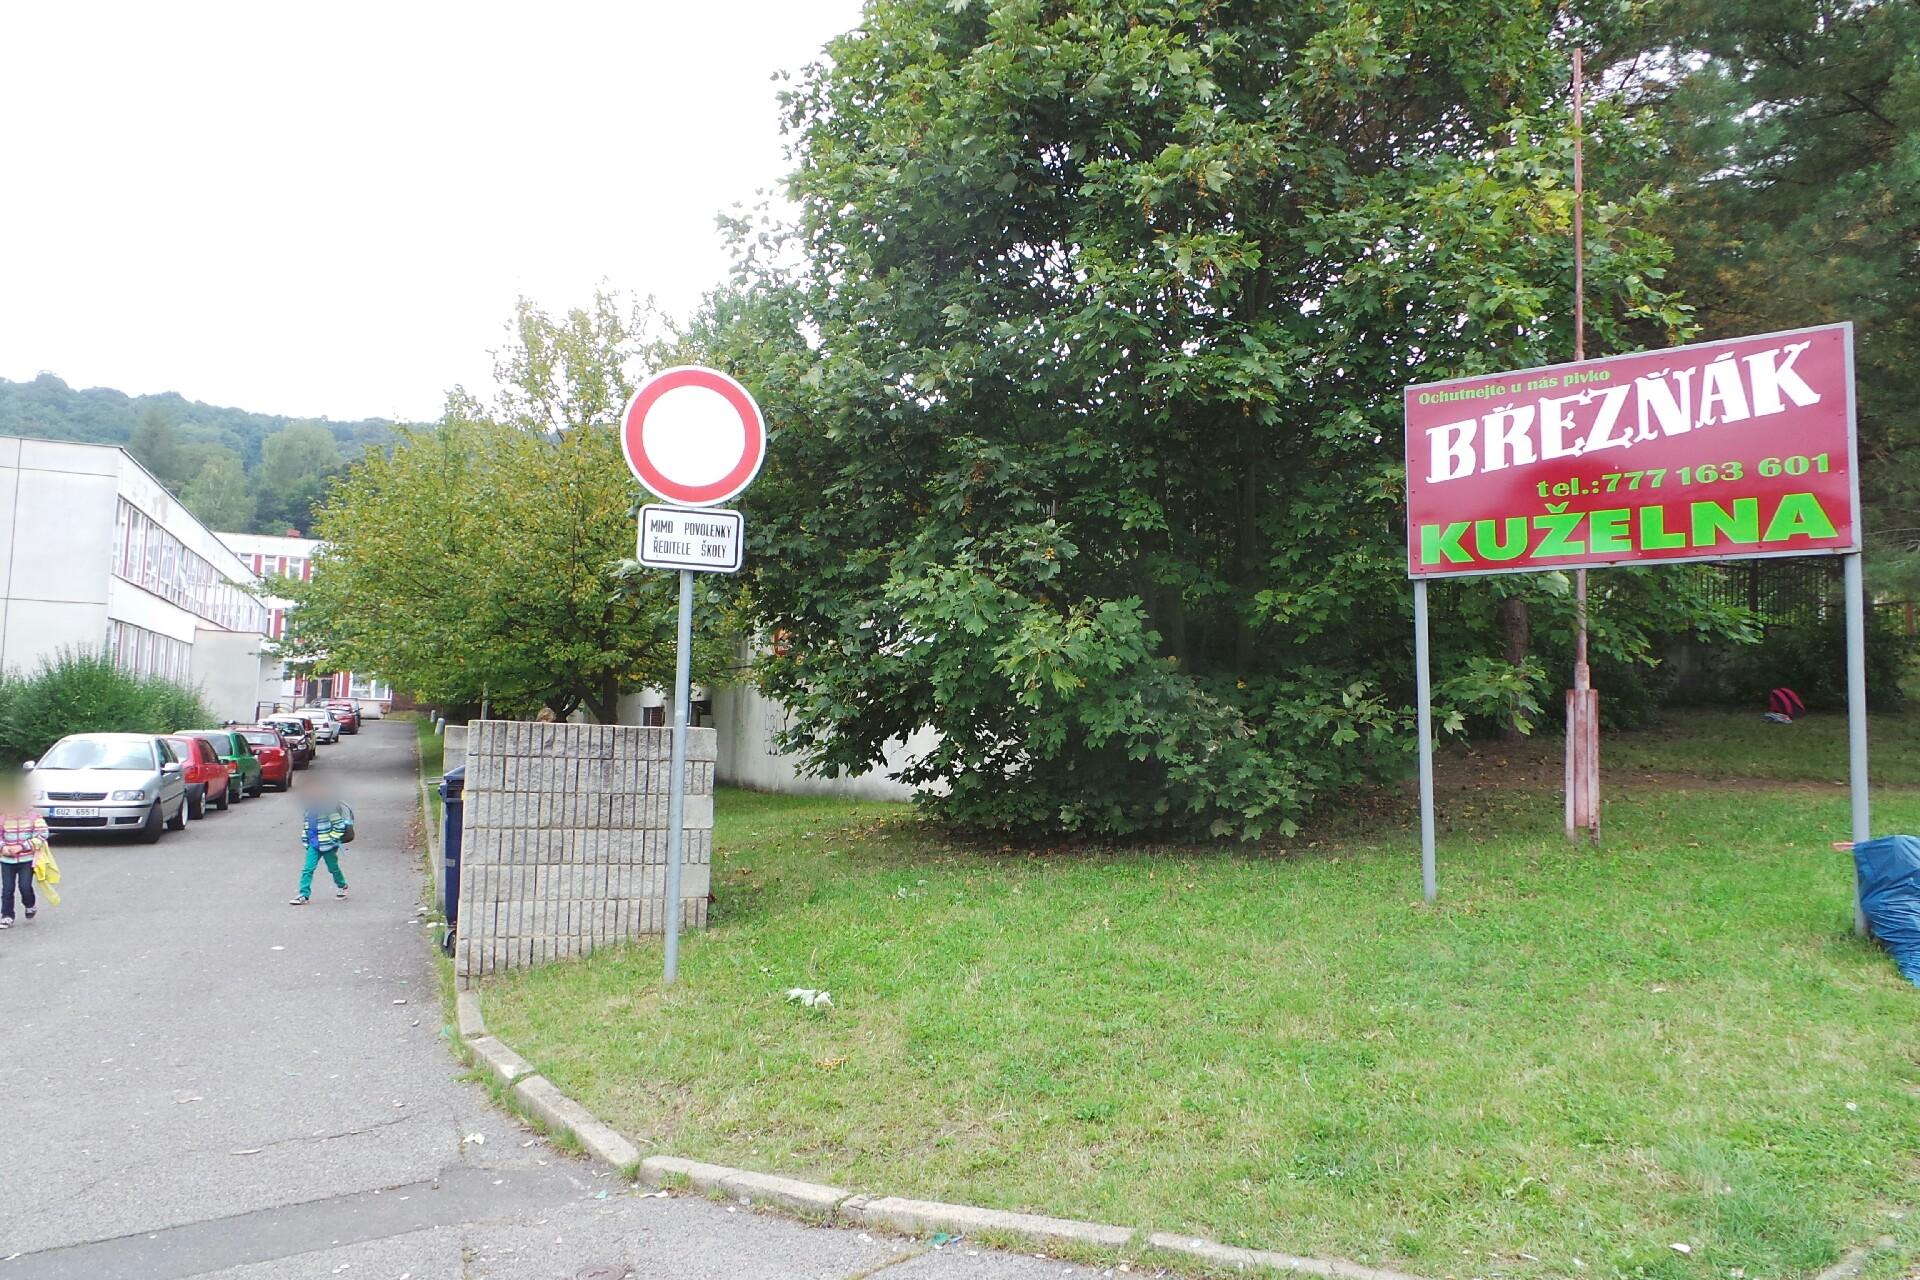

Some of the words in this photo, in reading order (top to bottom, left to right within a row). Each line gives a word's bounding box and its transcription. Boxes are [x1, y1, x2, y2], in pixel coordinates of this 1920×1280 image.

[1418, 385, 1506, 405] Ochutnejte
[1510, 384, 1522, 393] u
[1527, 376, 1558, 391] nás
[1563, 370, 1611, 387] pivko
[1424, 339, 1822, 484] BŘEZŇÁK
[1536, 468, 1667, 498] tel.:777
[1676, 461, 1744, 486] 163
[1758, 453, 1830, 477] 601
[650, 519, 674, 534] MIMO
[684, 522, 732, 539] POVOLENKY
[653, 536, 692, 556] ŘEDITELE
[701, 540, 727, 558] ŠKOLY
[1420, 491, 1839, 565] KUŽELNA
